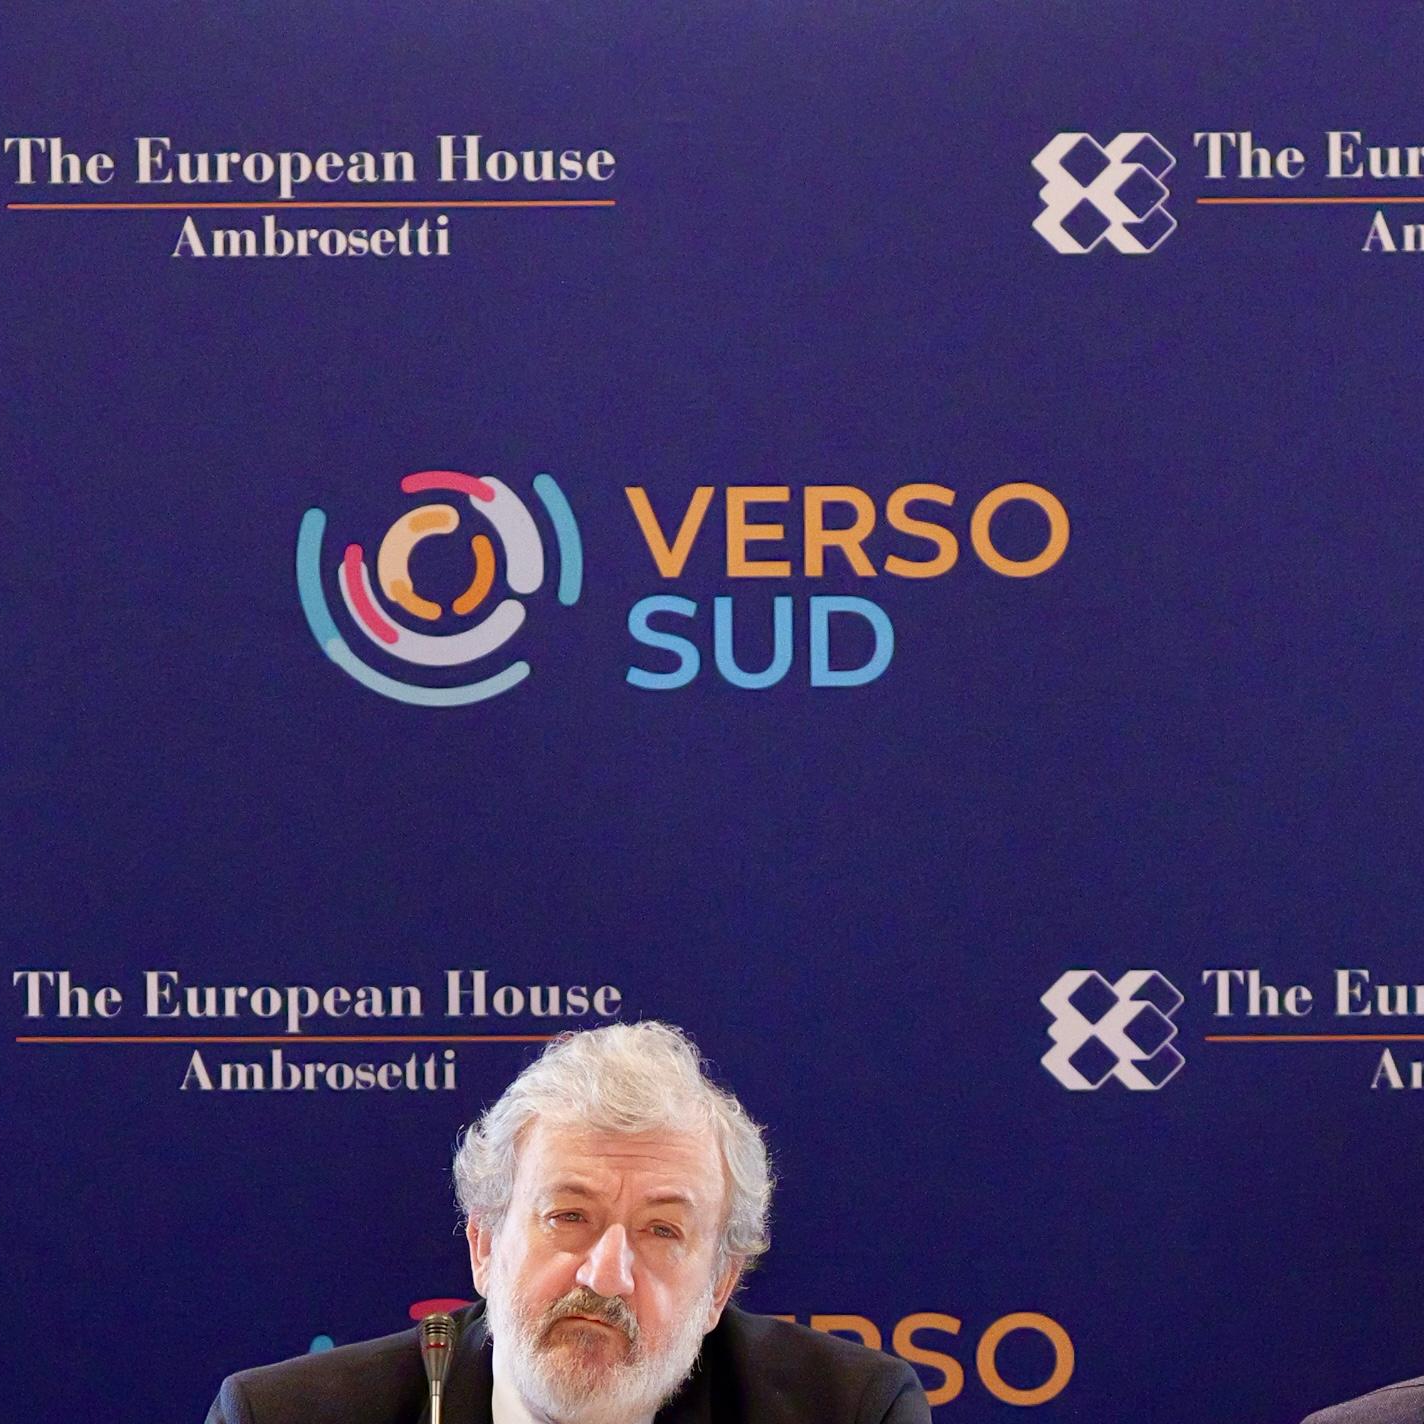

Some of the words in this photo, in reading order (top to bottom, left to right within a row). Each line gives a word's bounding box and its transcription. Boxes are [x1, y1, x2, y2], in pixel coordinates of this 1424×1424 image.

[4, 137, 115, 185] The
[135, 137, 415, 199] European
[436, 134, 616, 182] House
[1194, 131, 1304, 178] The
[172, 215, 451, 258] Ambrosetti
[624, 482, 1071, 579] VERSO
[625, 594, 895, 690] SUD
[13, 971, 122, 1018] The
[144, 971, 421, 1033] European
[447, 970, 622, 1018] House
[1203, 969, 1313, 1017] The
[180, 1048, 456, 1091] Ambrosetti
